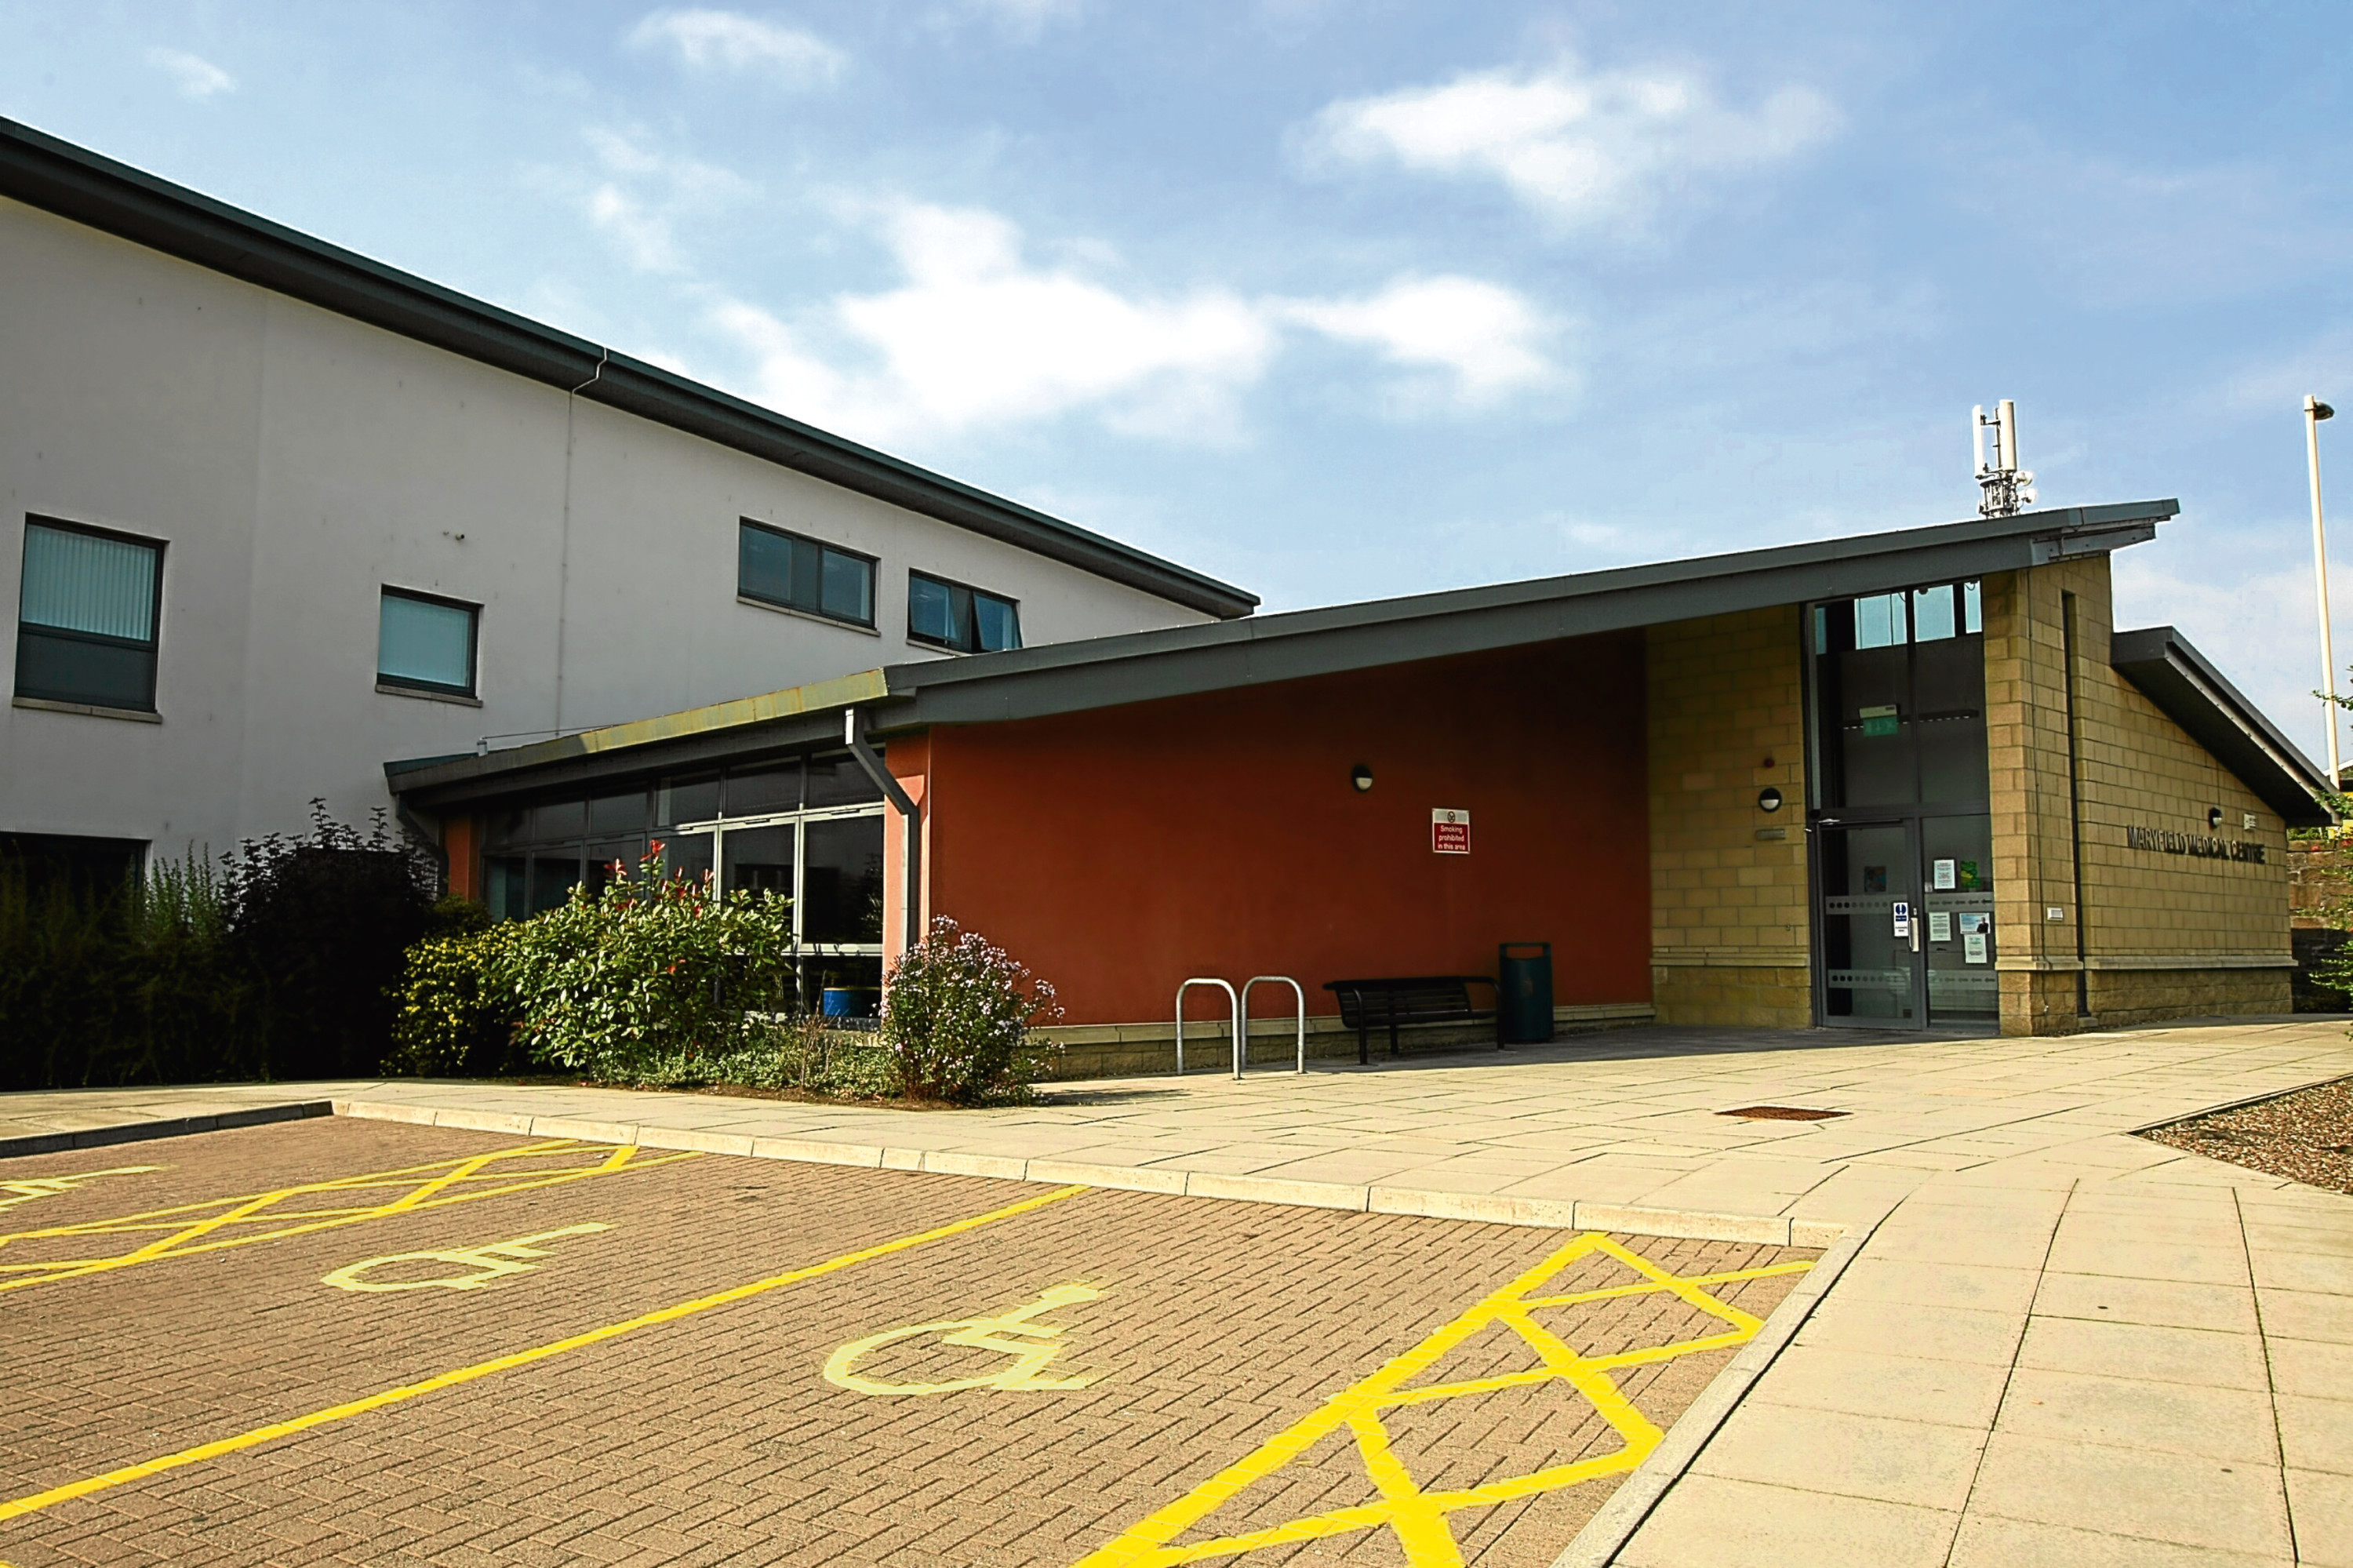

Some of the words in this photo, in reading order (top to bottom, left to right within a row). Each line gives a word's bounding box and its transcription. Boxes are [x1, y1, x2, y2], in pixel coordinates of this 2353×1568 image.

[1440, 825, 1462, 834] Smoking
[2128, 826, 2185, 854] MARYFIELD
[2188, 834, 2229, 860] MEDICAL
[2230, 840, 2266, 864] CENTRE
